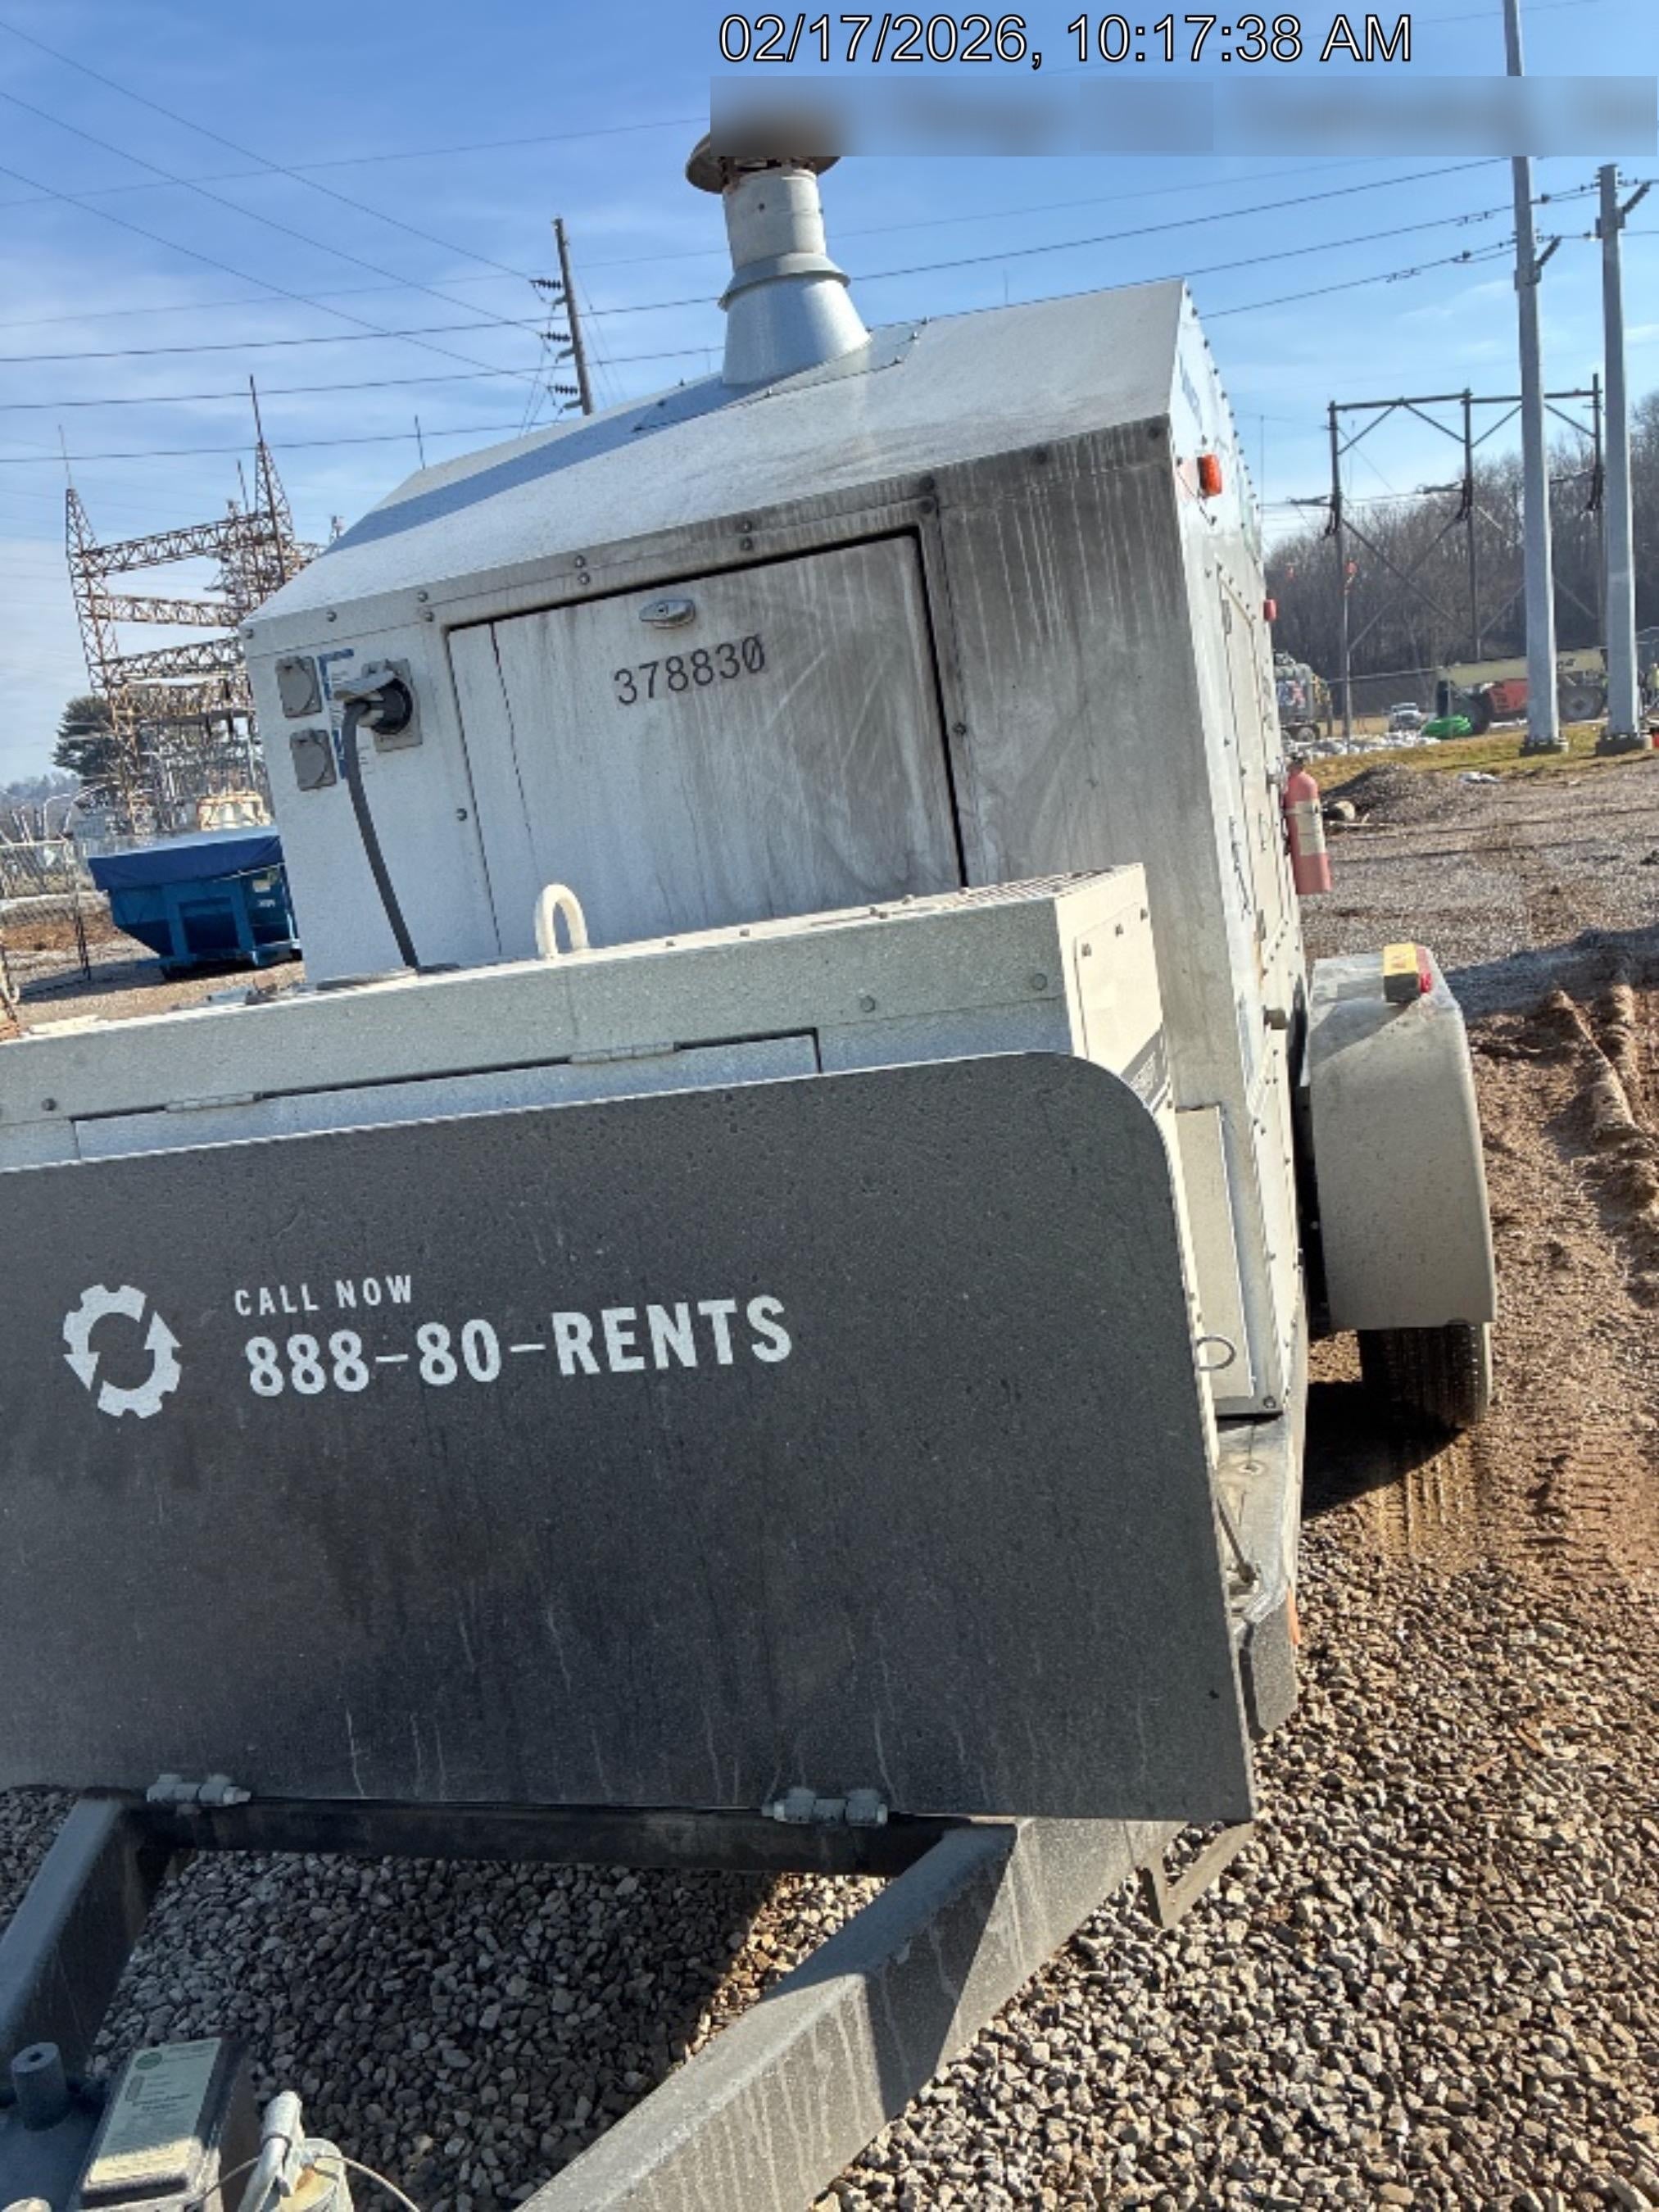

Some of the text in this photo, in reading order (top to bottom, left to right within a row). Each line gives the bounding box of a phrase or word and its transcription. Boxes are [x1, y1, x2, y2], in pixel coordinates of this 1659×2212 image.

[614, 634, 765, 705] 378830
[234, 1276, 411, 1316] CALL NOW
[245, 1294, 792, 1397] 888-80-RENTS
